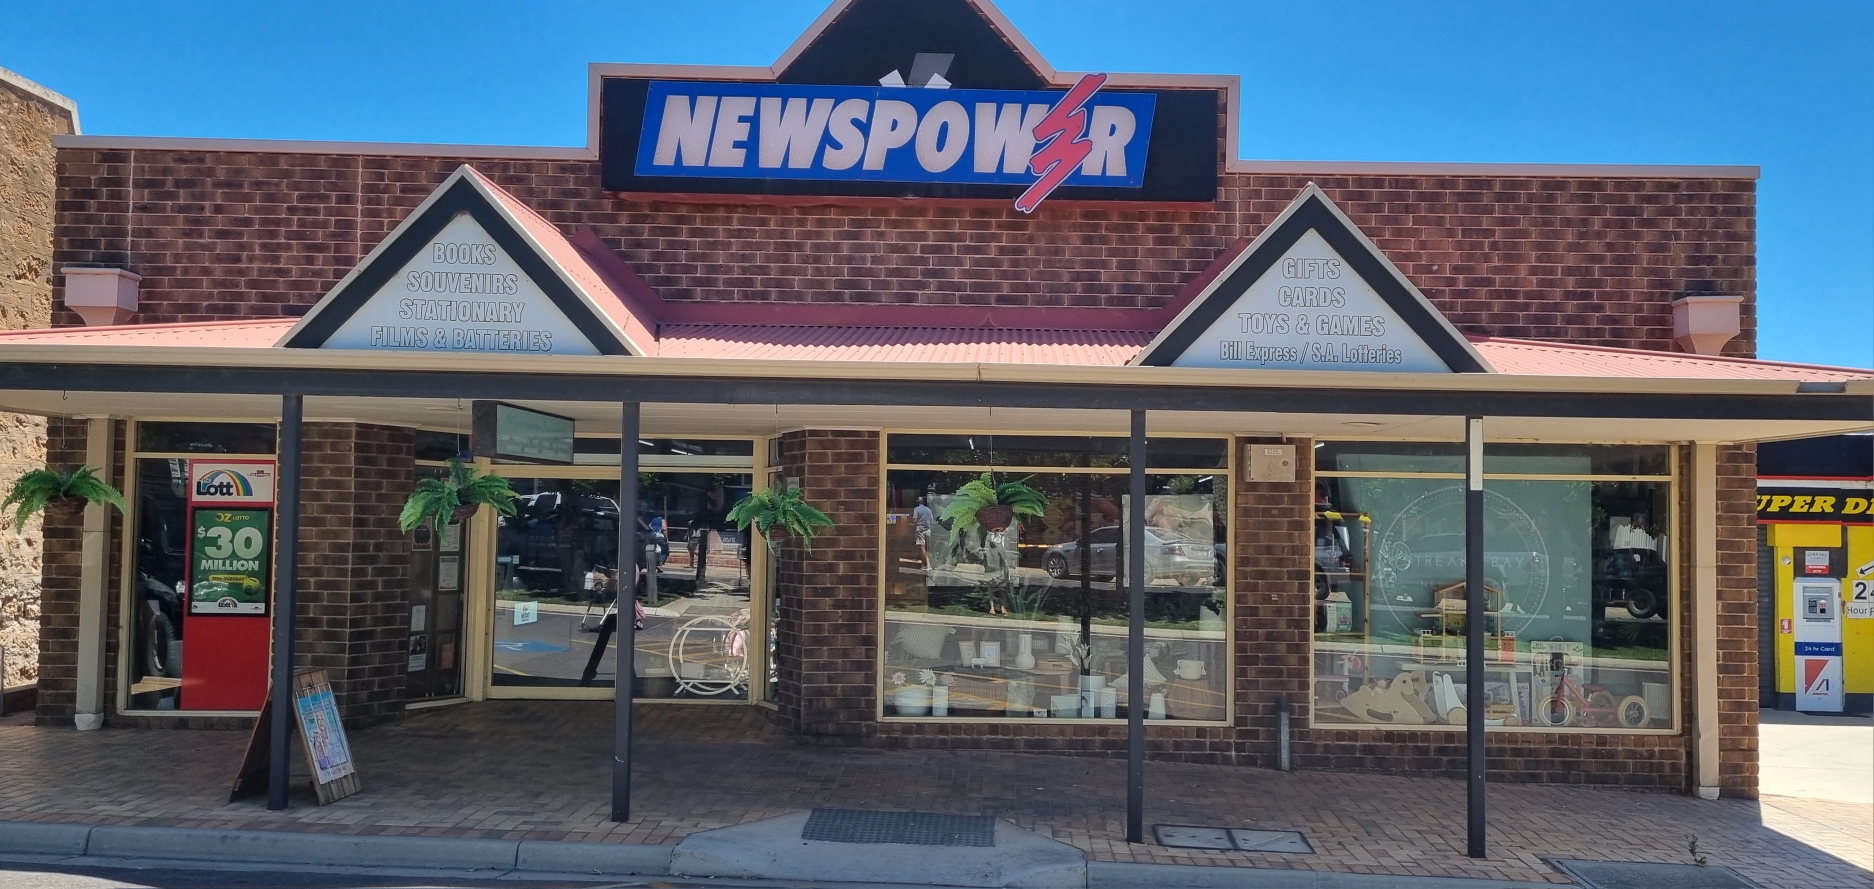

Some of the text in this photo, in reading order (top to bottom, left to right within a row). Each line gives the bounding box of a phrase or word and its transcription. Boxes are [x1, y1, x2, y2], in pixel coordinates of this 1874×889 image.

[653, 75, 1137, 211] NEWSPOWER
[432, 242, 497, 266] BOOKS
[1282, 257, 1341, 280] GIFTS
[406, 270, 519, 296] SOUVENIRS
[1278, 286, 1346, 309] CARDS
[398, 298, 526, 324] STATIONARY
[1238, 313, 1386, 337] TOYS & GAMES
[370, 325, 553, 352] FILMS & BATTERIES
[1219, 340, 1403, 365] Bill Express / S.A. Lotteries
[196, 480, 234, 496] Lott
[1757, 495, 1836, 513] UPER
[215, 512, 232, 523] OZ
[197, 525, 263, 560] $30
[200, 559, 259, 571] MILLION
[1491, 556, 1525, 568] BAY
[1847, 606, 1868, 615] Hour
